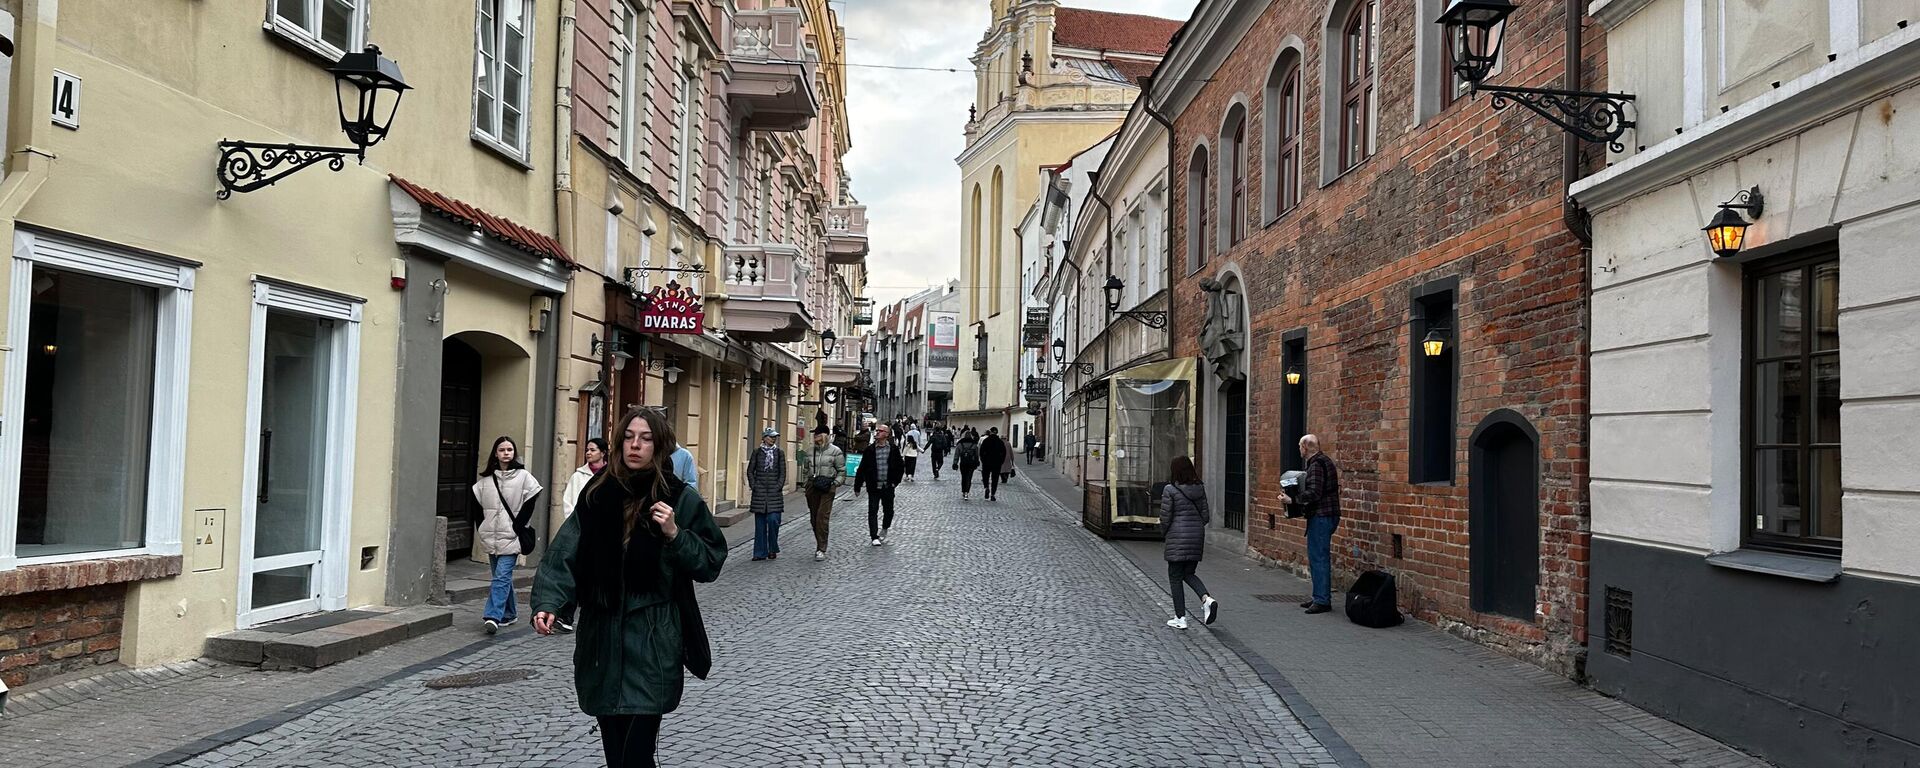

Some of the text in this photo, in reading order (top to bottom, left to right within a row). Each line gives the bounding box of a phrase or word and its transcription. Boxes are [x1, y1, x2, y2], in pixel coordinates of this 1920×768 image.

[52, 76, 74, 119] 14
[657, 301, 686, 313] ETNO
[644, 315, 697, 329] DVARAS
